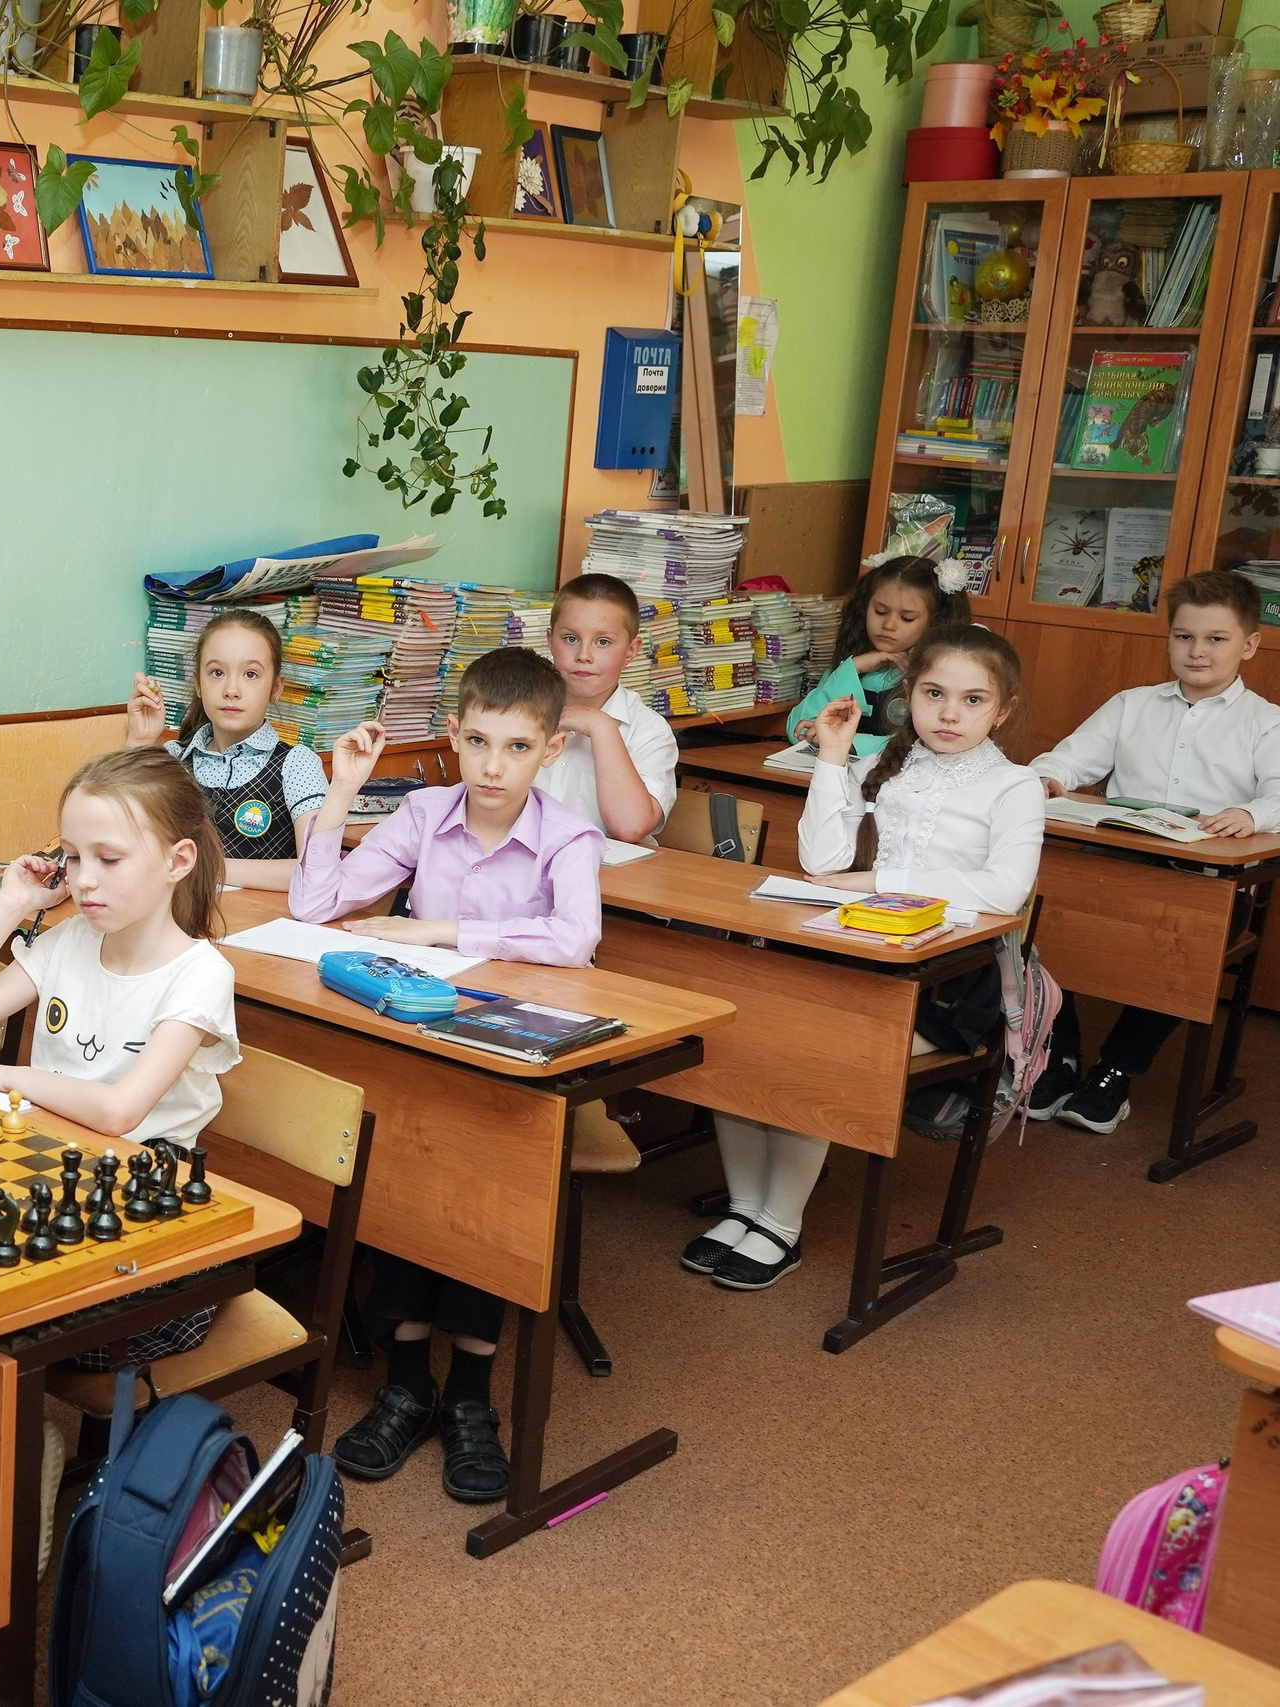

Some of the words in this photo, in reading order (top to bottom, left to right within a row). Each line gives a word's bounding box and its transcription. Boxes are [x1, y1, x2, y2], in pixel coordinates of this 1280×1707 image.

[633, 346, 672, 366] ПОЧТА
[642, 368, 664, 378] Почта
[1093, 371, 1138, 380] БОЛЬШАЯ
[637, 383, 667, 394] доверия
[1092, 381, 1166, 391] ЭНЦИКЛОПЕДИЯ
[238, 822, 262, 833] ШКОЛА
